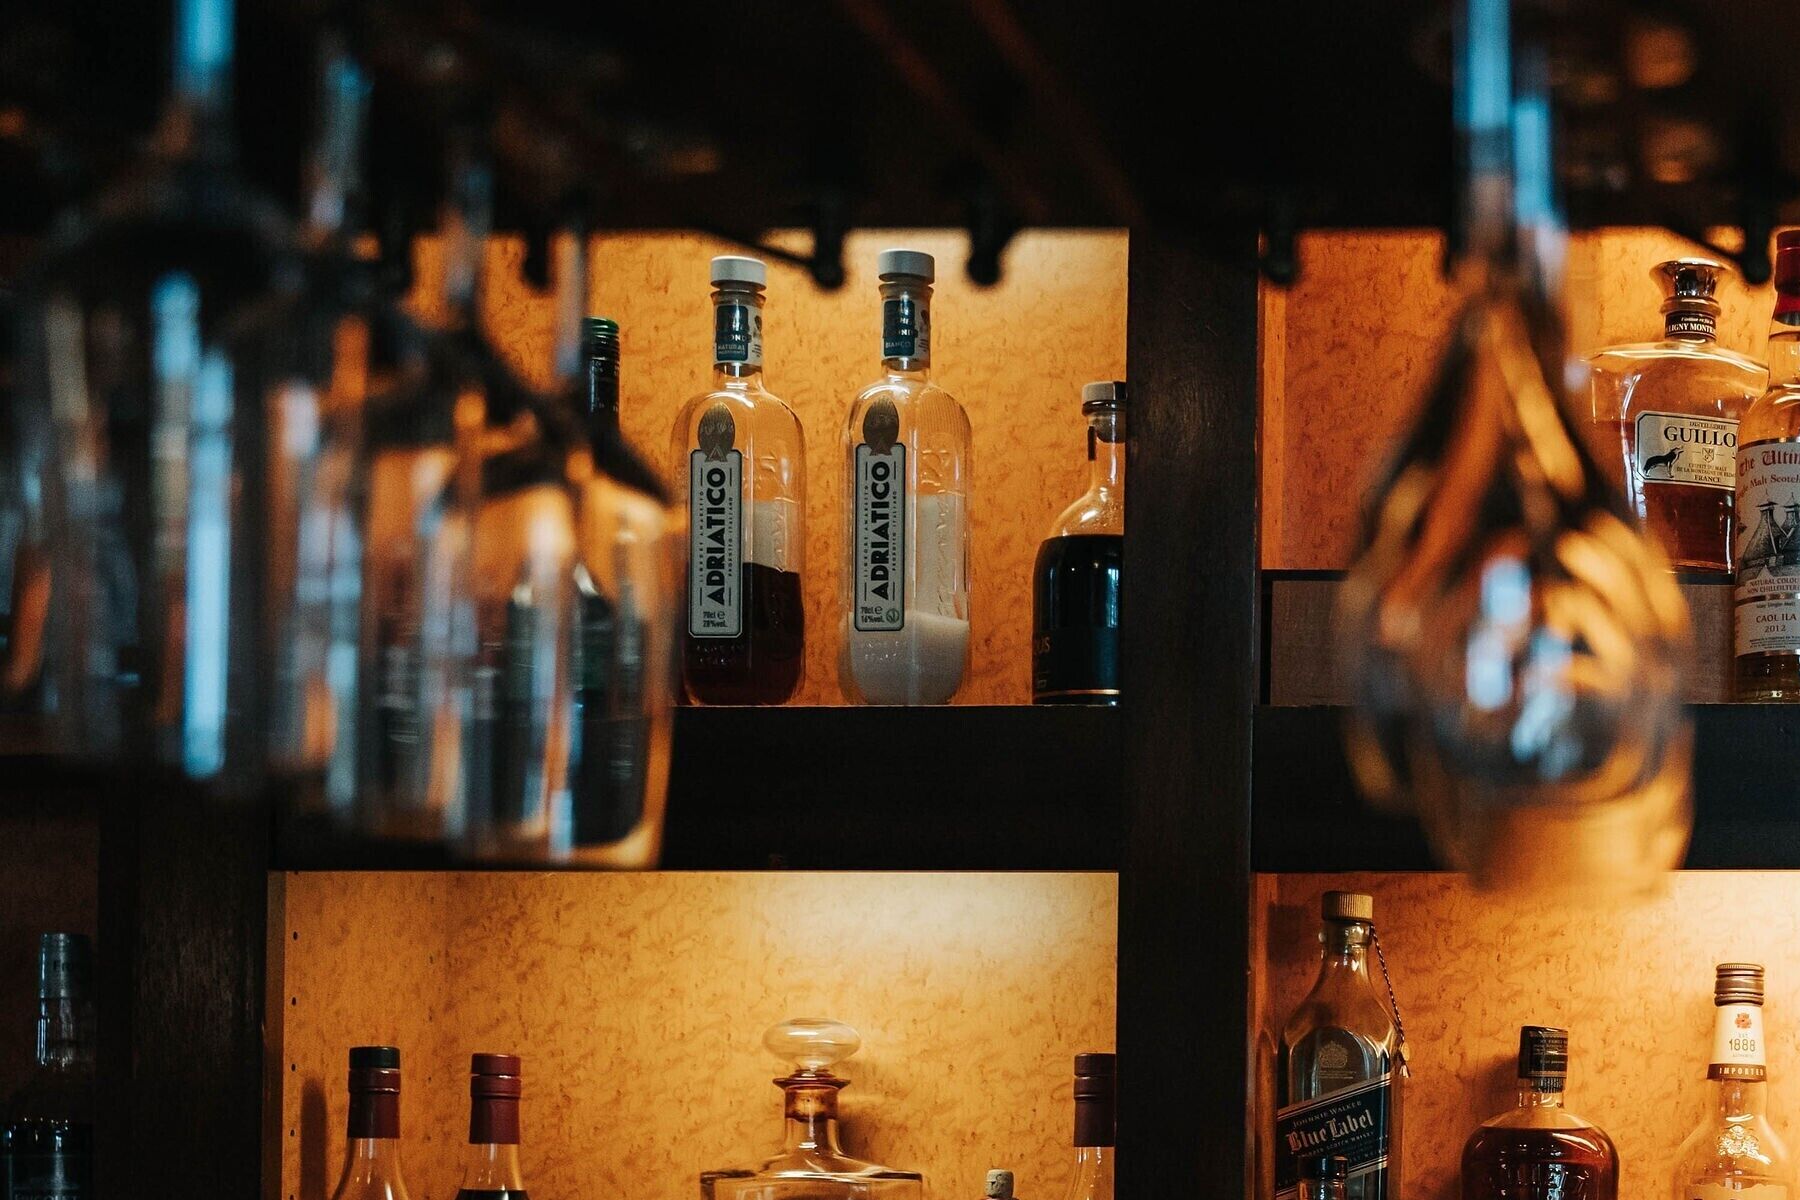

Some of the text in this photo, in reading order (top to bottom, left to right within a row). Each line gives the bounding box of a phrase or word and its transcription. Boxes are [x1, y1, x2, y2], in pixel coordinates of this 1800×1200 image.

[1694, 475, 1721, 483] FRANCE
[1770, 474, 1800, 484] Scotch
[706, 467, 726, 605] ADRIATICO
[871, 461, 891, 600] ADRIATICO
[1756, 614, 1780, 623] CAOL
[1764, 625, 1786, 633] 2012
[1729, 1039, 1756, 1052] 1888
[1286, 1109, 1374, 1155] Blue Label
